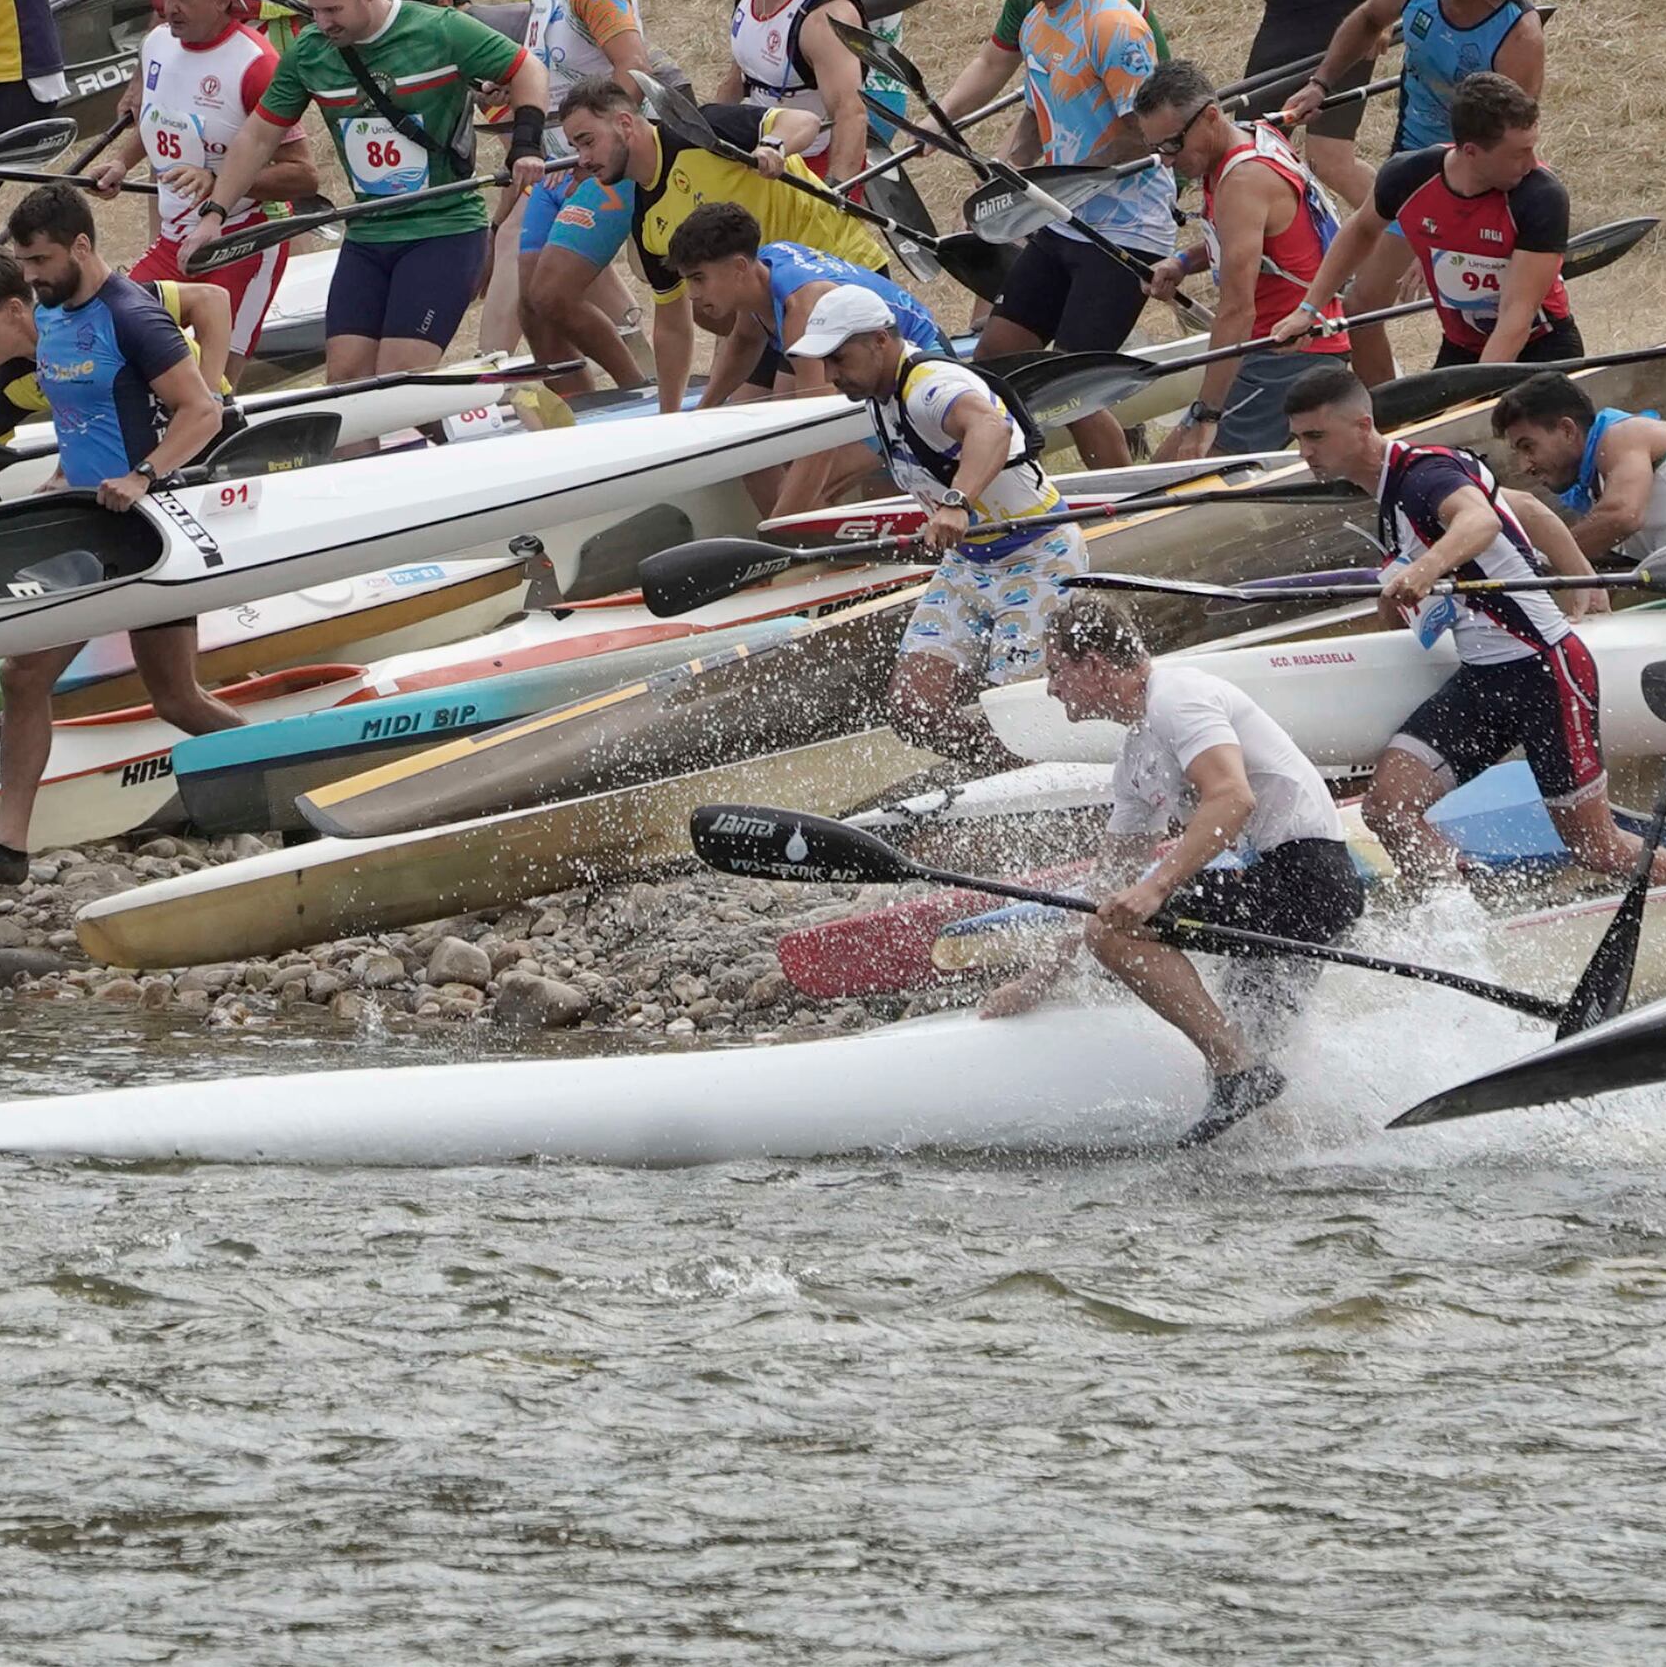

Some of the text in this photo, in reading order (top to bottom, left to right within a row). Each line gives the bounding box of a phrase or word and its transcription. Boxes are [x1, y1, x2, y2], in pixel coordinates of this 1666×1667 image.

[156, 130, 181, 160] 85
[366, 141, 401, 168] 86
[1461, 271, 1501, 292] 94
[416, 308, 435, 335] icon
[221, 483, 249, 507] 91
[1293, 652, 1356, 666] RIBADESELLA
[361, 704, 477, 741] MIDI BIP
